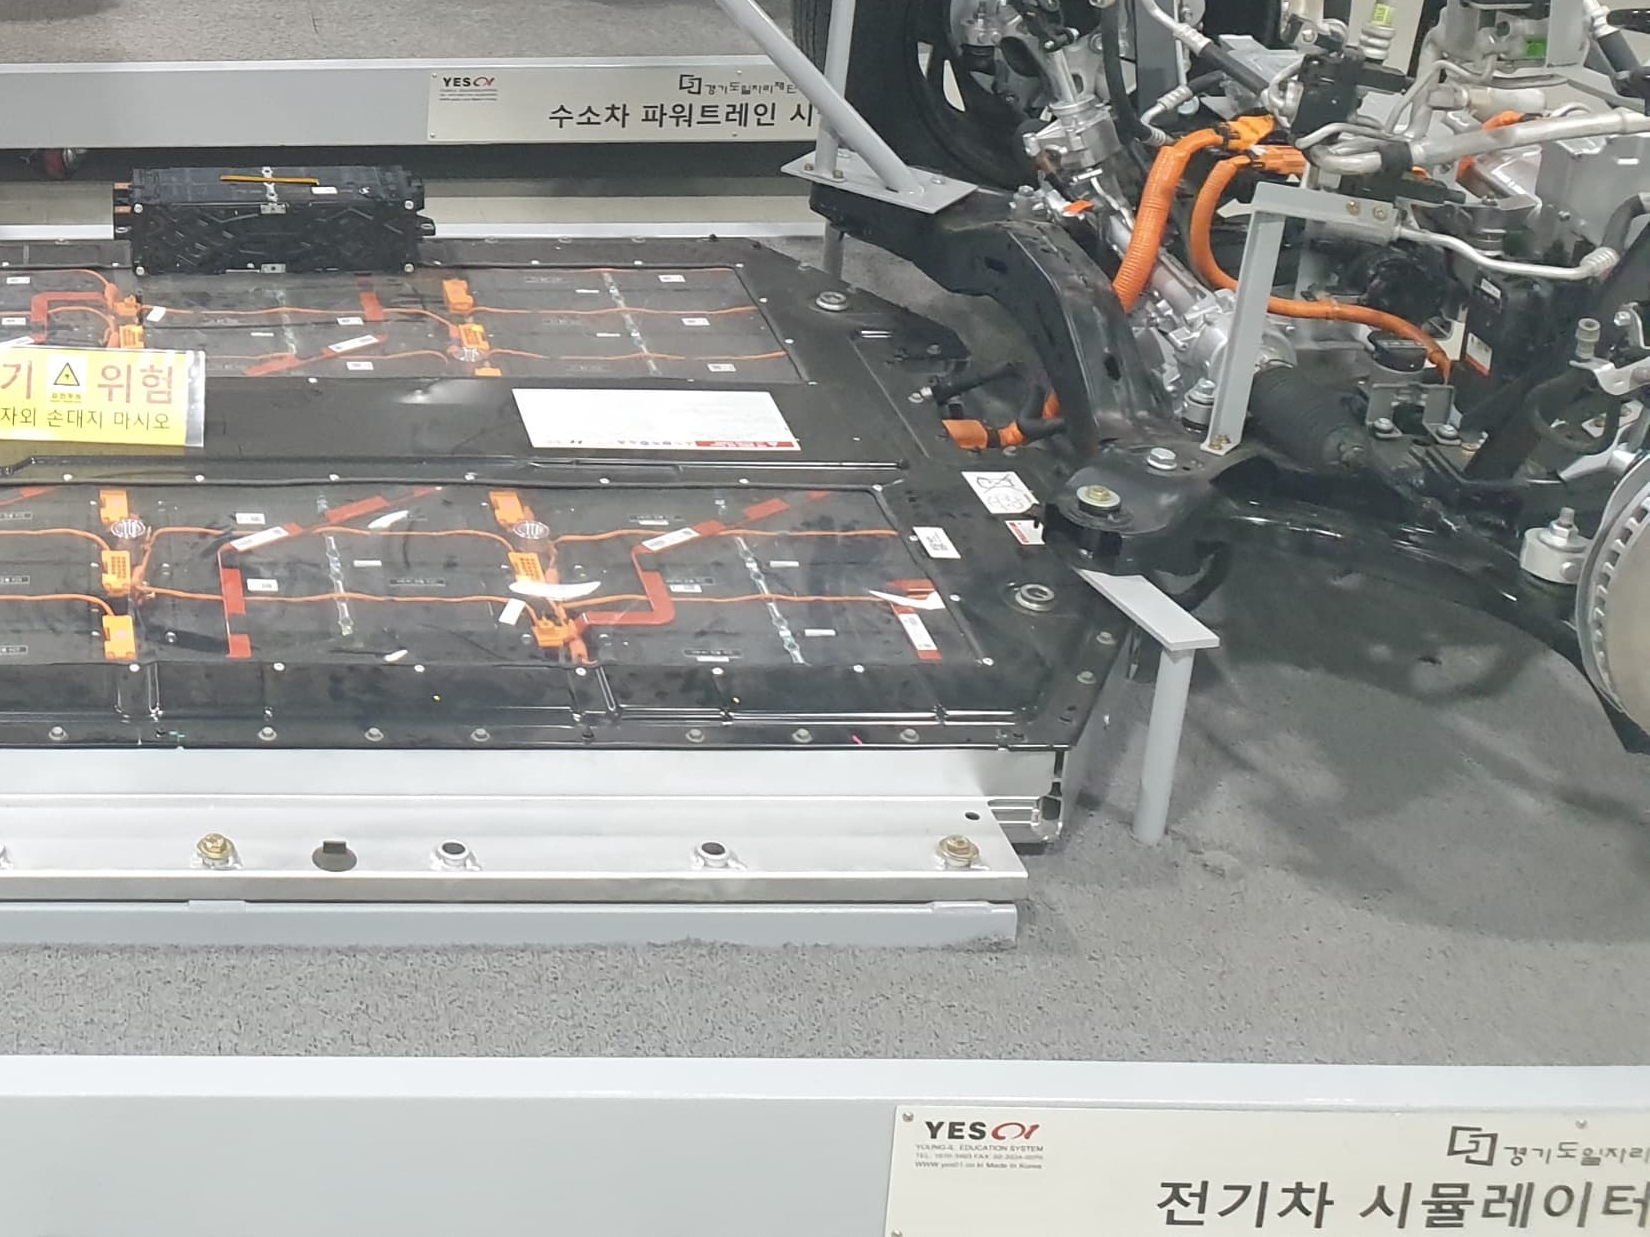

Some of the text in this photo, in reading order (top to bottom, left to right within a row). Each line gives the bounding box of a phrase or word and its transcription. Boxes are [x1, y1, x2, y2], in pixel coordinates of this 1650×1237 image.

[549, 103, 630, 128] 수소차
[641, 102, 777, 128] 파워트레인
[97, 363, 174, 404] 위험
[47, 409, 103, 429] 손대지
[114, 411, 170, 431] 마시오
[1156, 1181, 1650, 1229] 전기차 시뮬레이터
